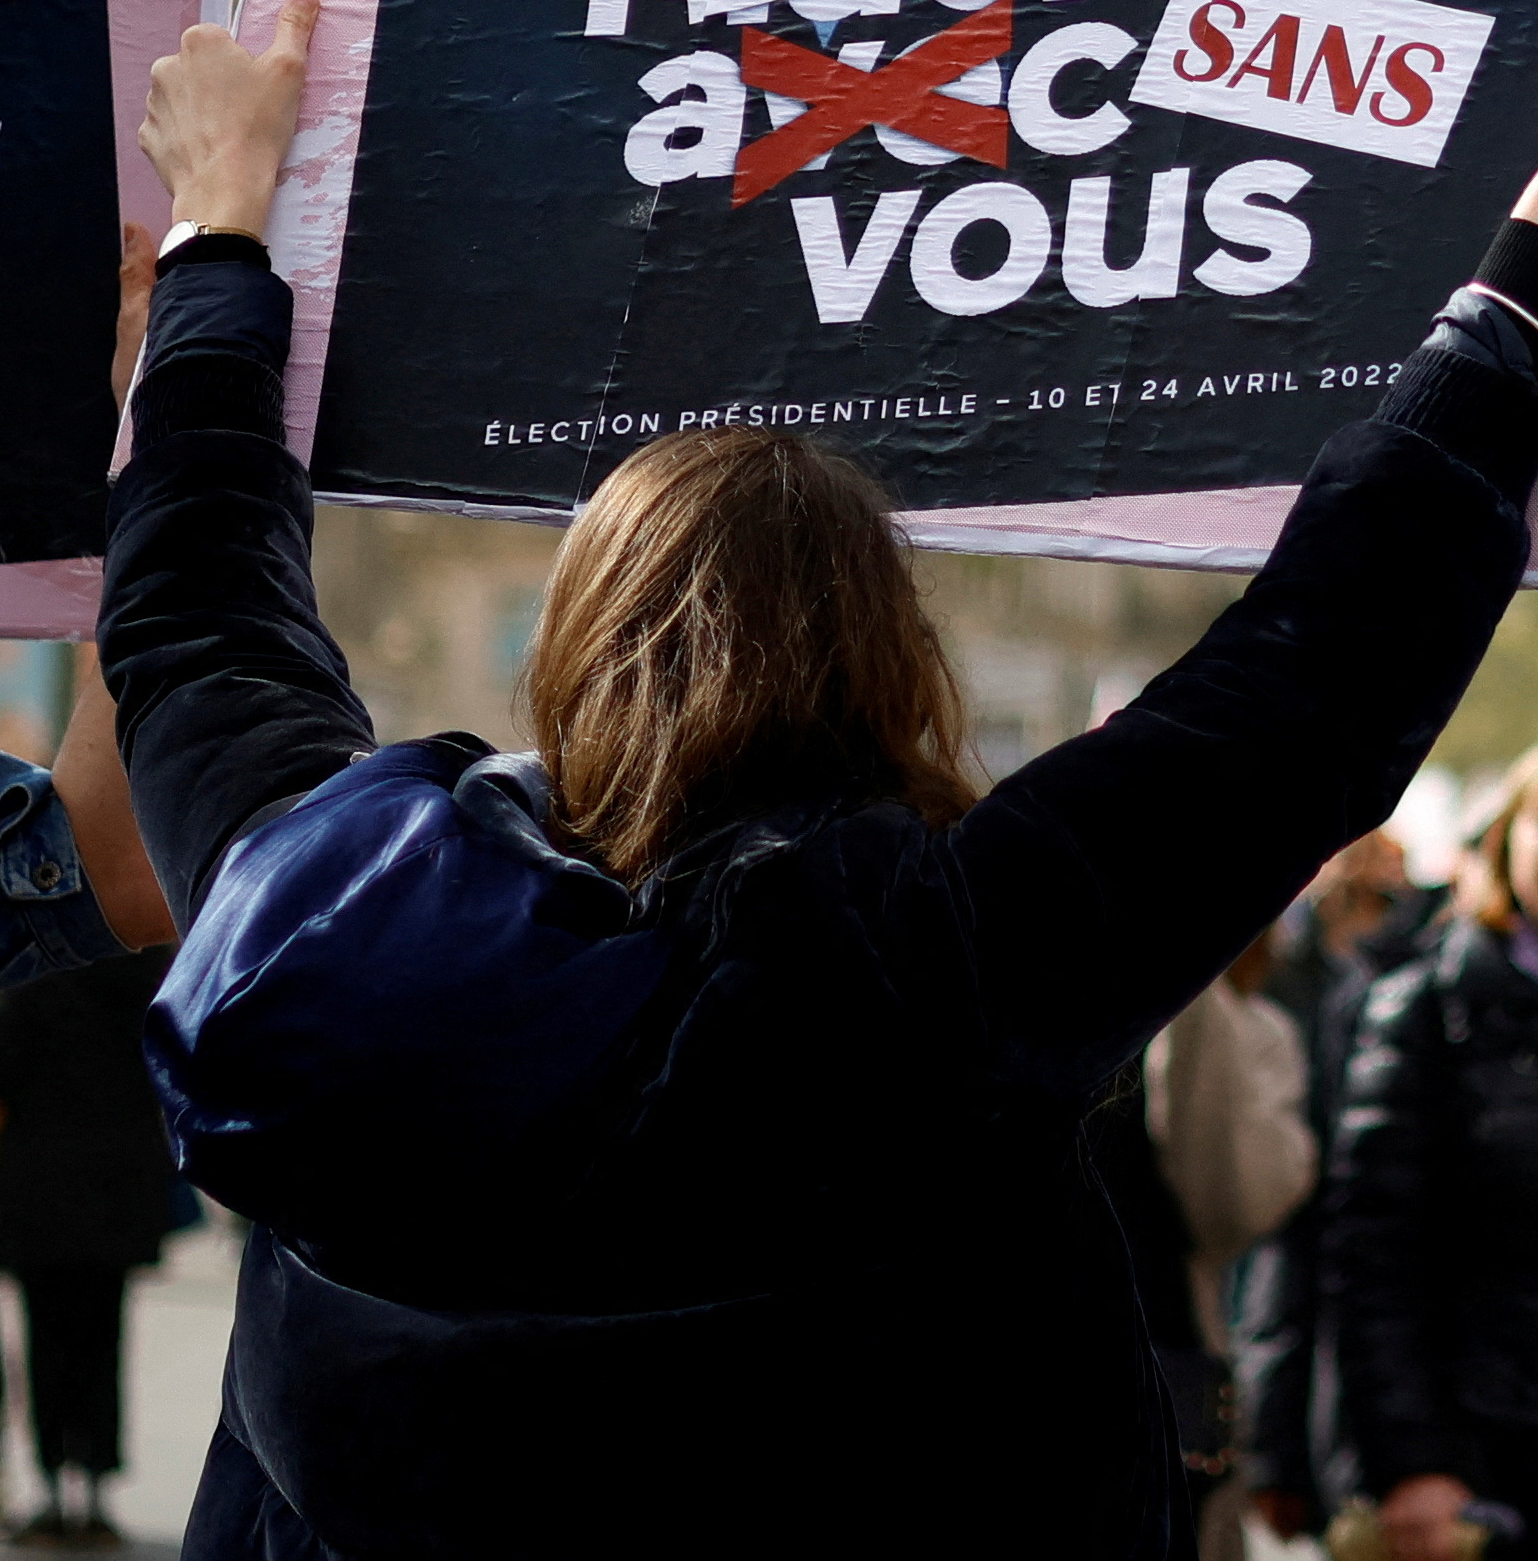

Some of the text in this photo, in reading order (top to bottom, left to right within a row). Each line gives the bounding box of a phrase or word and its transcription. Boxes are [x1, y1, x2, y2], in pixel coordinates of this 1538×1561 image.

[791, 158, 1313, 325] vous
[484, 413, 660, 445] ÉLECTION
[678, 393, 978, 431] PRÉSIDENTIELLE
[1028, 387, 1066, 411] 10
[1085, 383, 1122, 407] ET
[1141, 377, 1179, 401] 24
[1196, 370, 1301, 397] AVRIL
[1319, 362, 1403, 389] 2022
